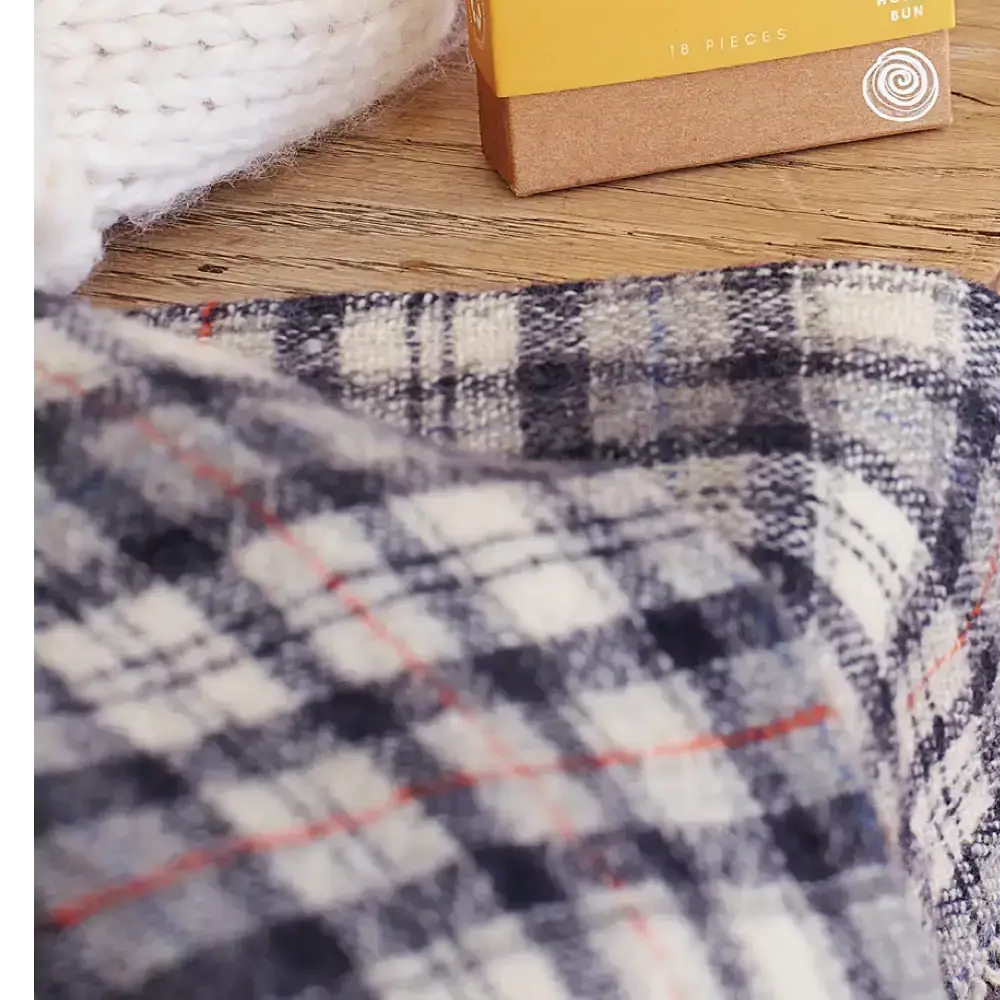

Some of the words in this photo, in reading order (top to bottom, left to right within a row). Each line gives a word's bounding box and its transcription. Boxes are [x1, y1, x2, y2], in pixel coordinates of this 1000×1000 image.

[890, 4, 924, 22] BUN
[668, 41, 690, 58] 18
[706, 27, 788, 51] PIECES
